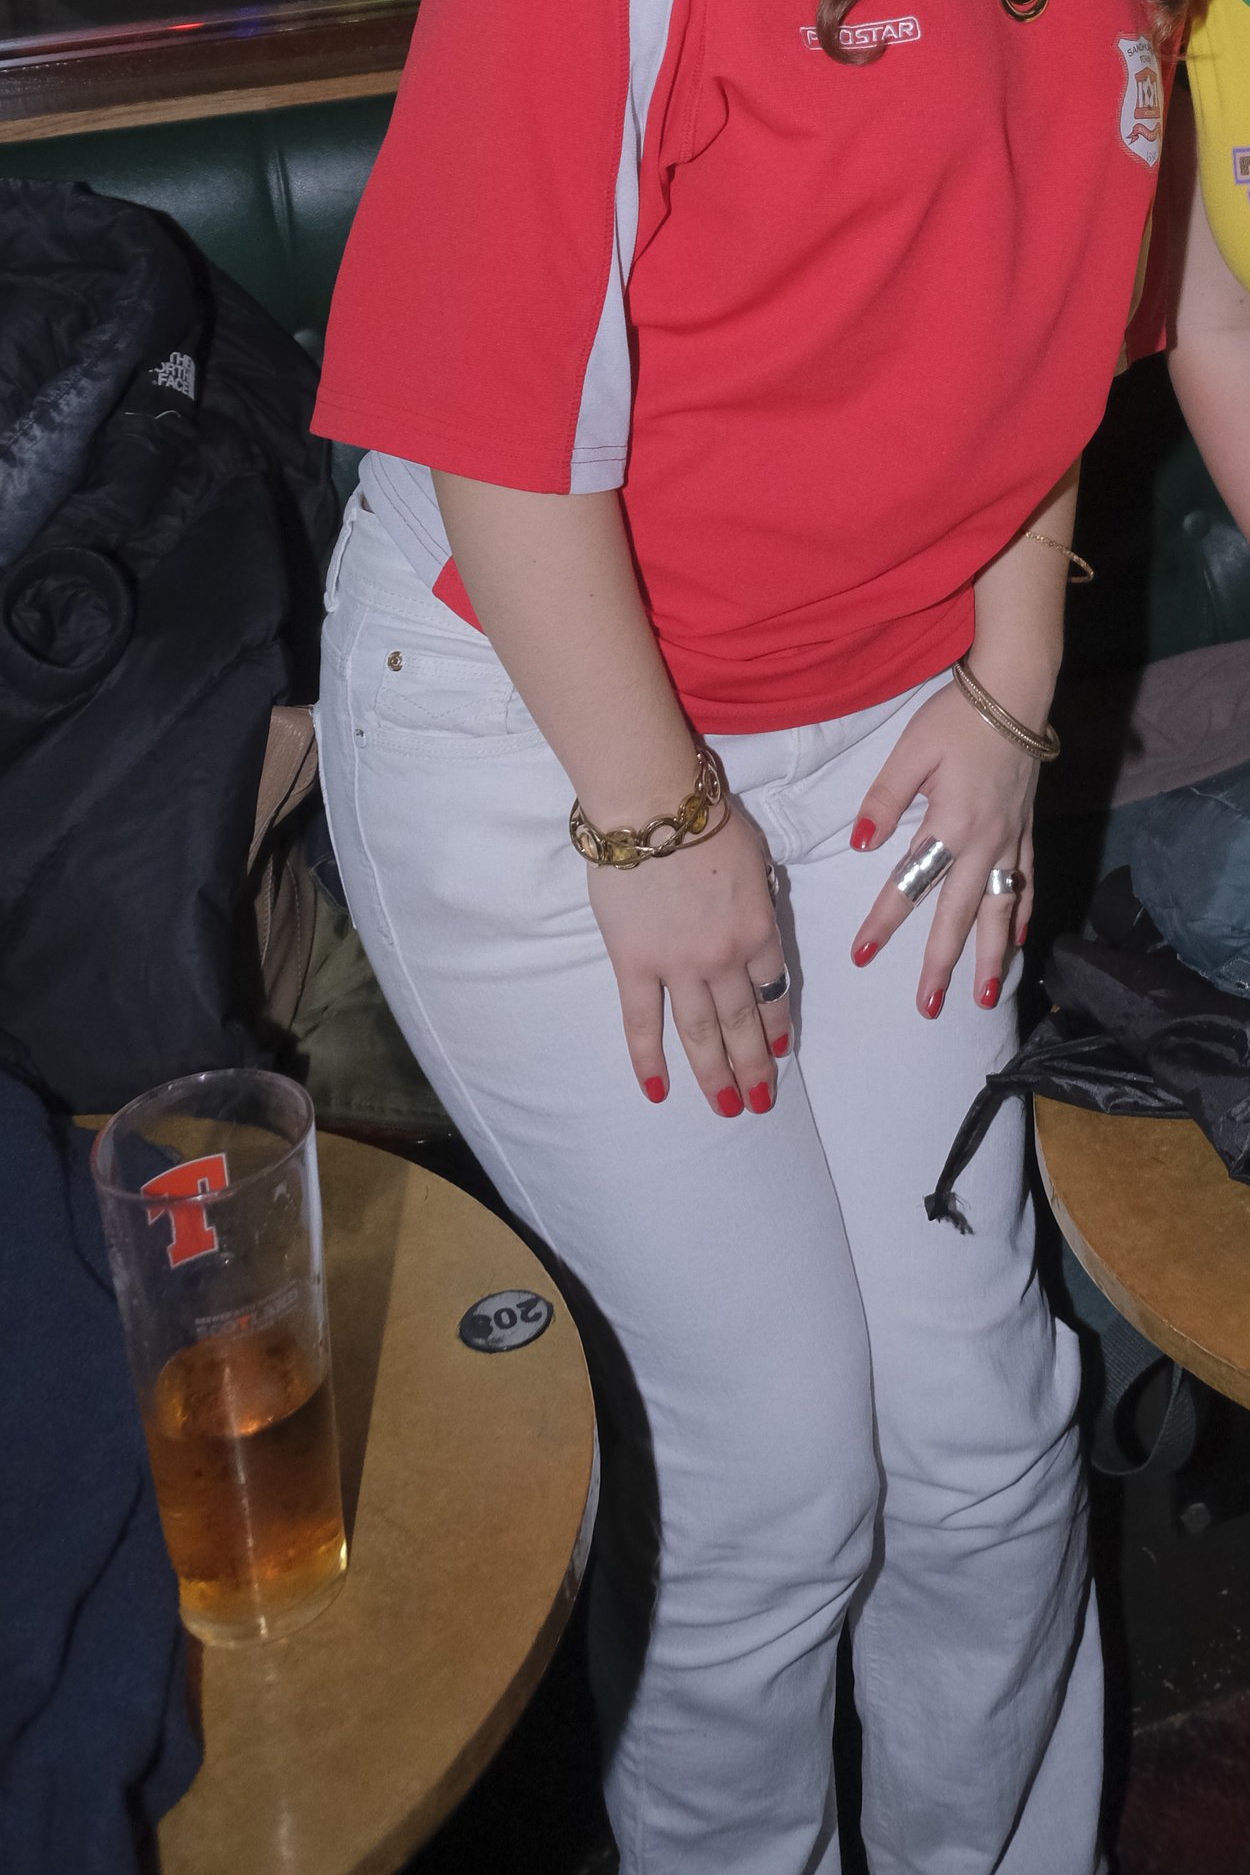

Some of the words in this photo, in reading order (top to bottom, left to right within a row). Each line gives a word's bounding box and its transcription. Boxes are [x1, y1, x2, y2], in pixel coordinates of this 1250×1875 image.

[807, 22, 914, 45] POSTAR
[170, 351, 192, 368] THE
[158, 373, 193, 396] FACE
[140, 1153, 230, 1268] T
